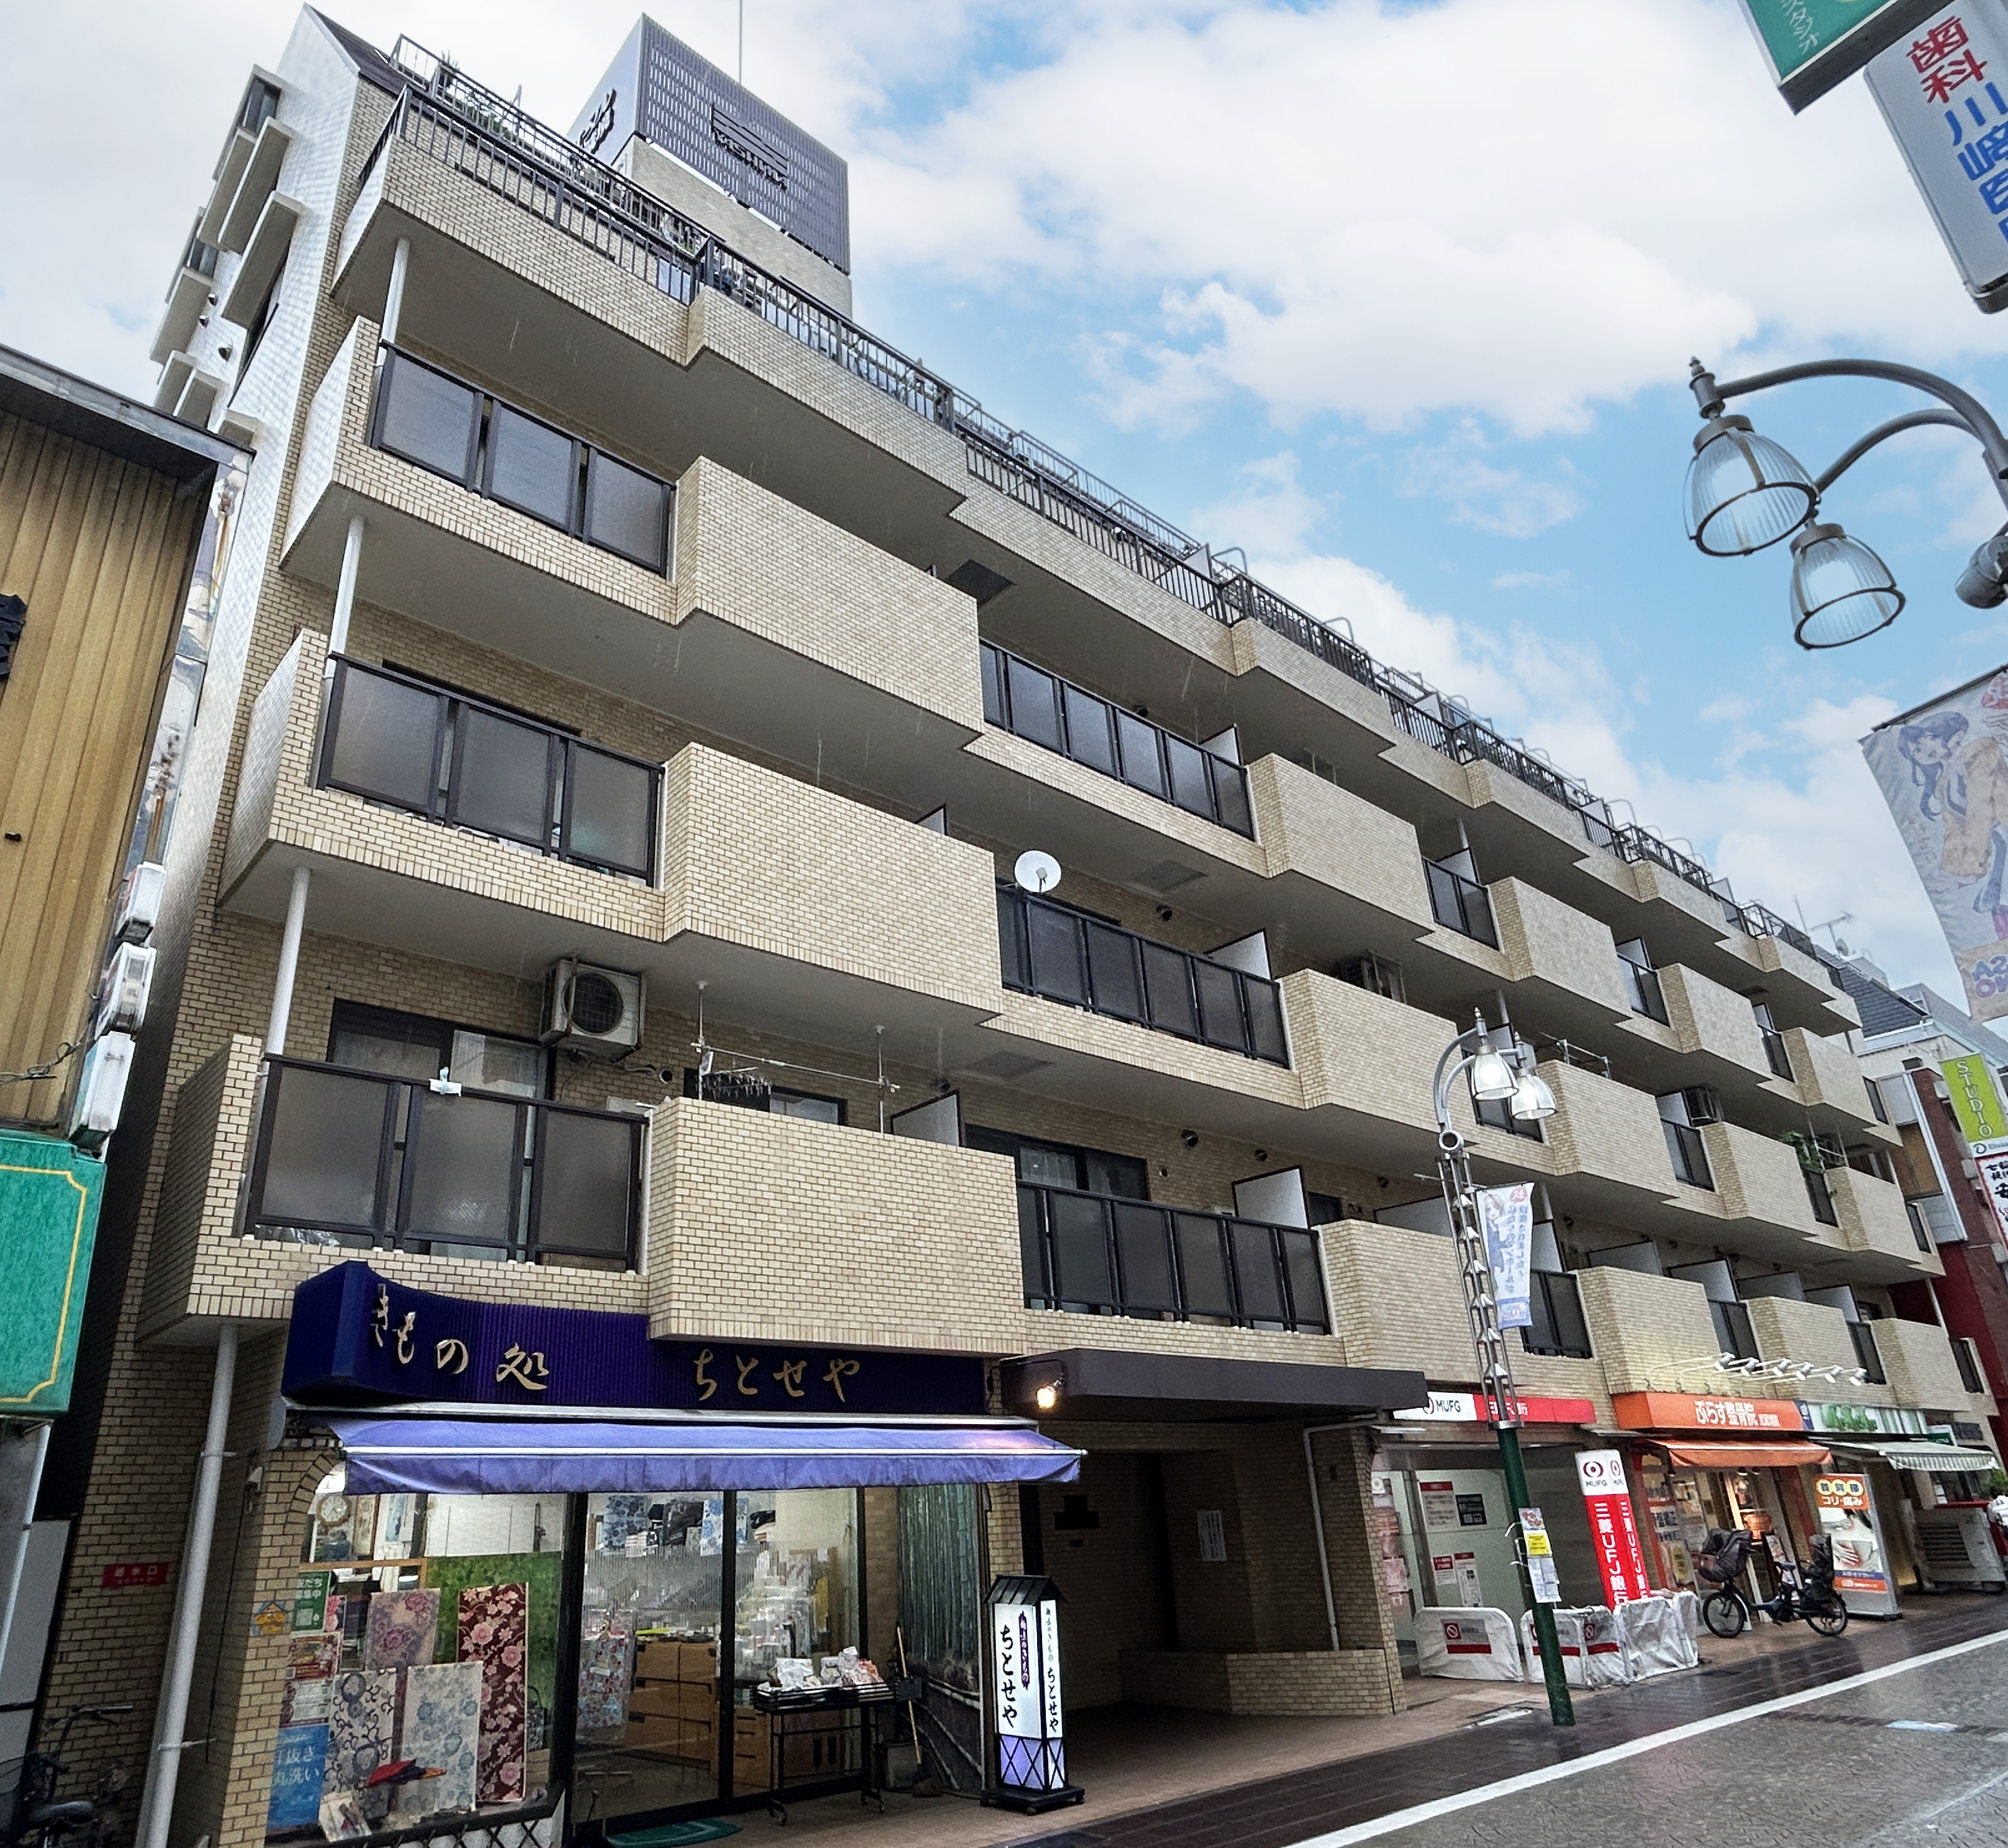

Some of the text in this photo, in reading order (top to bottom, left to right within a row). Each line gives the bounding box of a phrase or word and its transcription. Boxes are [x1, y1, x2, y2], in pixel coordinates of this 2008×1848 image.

[1956, 1060, 1992, 1139] STUDIO
[371, 1284, 860, 1403] きもの処 ちとせや
[1436, 1400, 1461, 1413] MUFG
[1000, 1624, 1018, 1728] ちとせや
[1047, 1667, 1059, 1733] ちとせや
